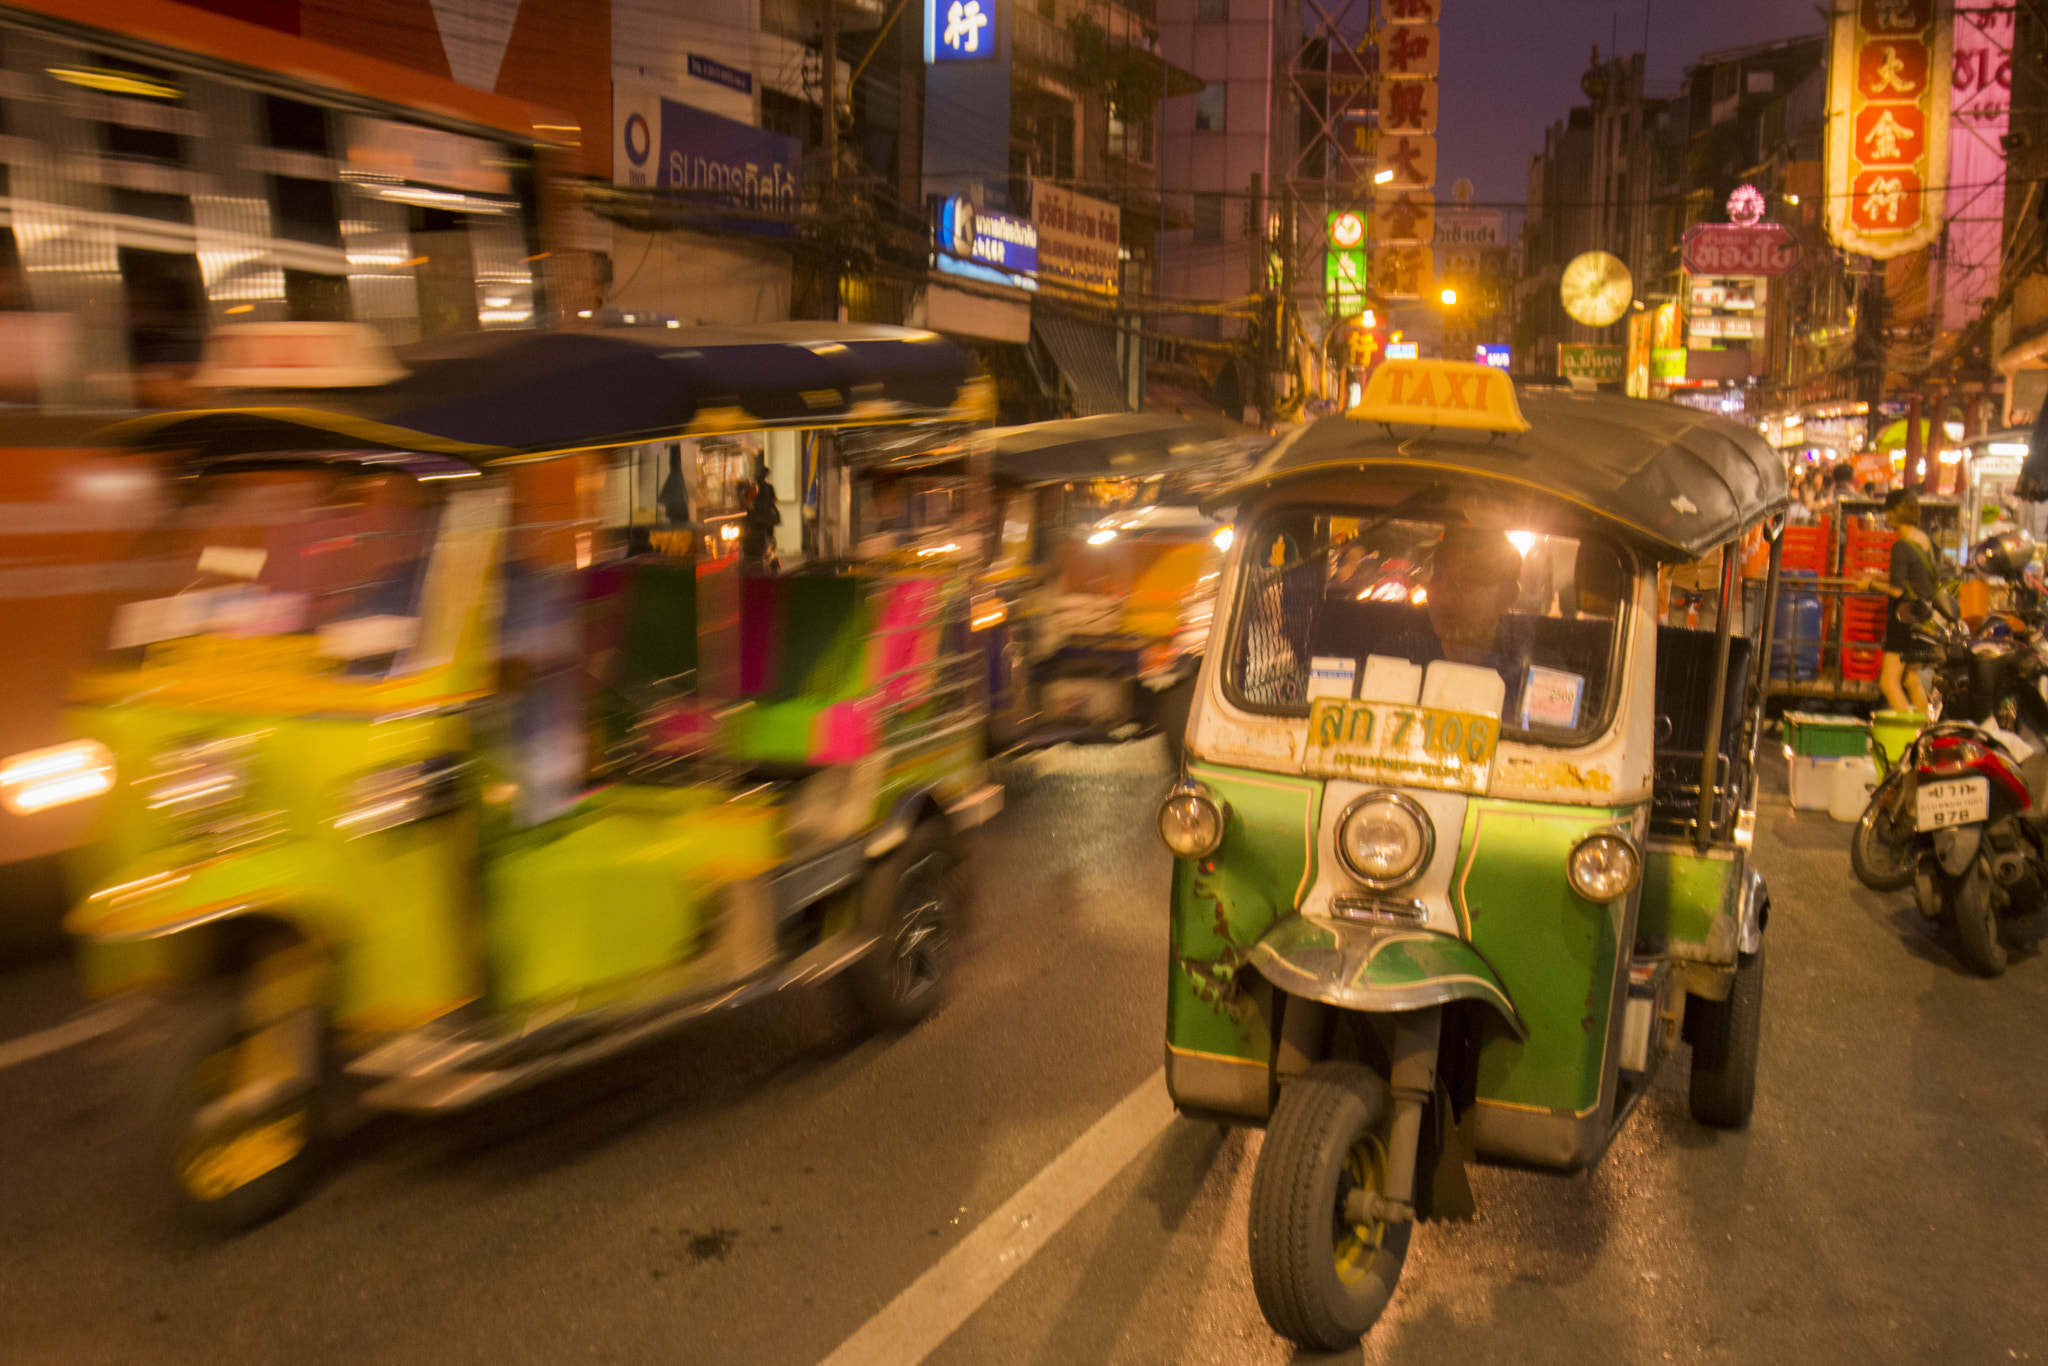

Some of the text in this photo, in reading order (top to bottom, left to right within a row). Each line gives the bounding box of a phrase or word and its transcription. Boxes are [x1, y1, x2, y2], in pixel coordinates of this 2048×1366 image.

[943, 0, 988, 53] 行
[1385, 367, 1493, 411] TAXI
[1393, 711, 1490, 758] 7108
